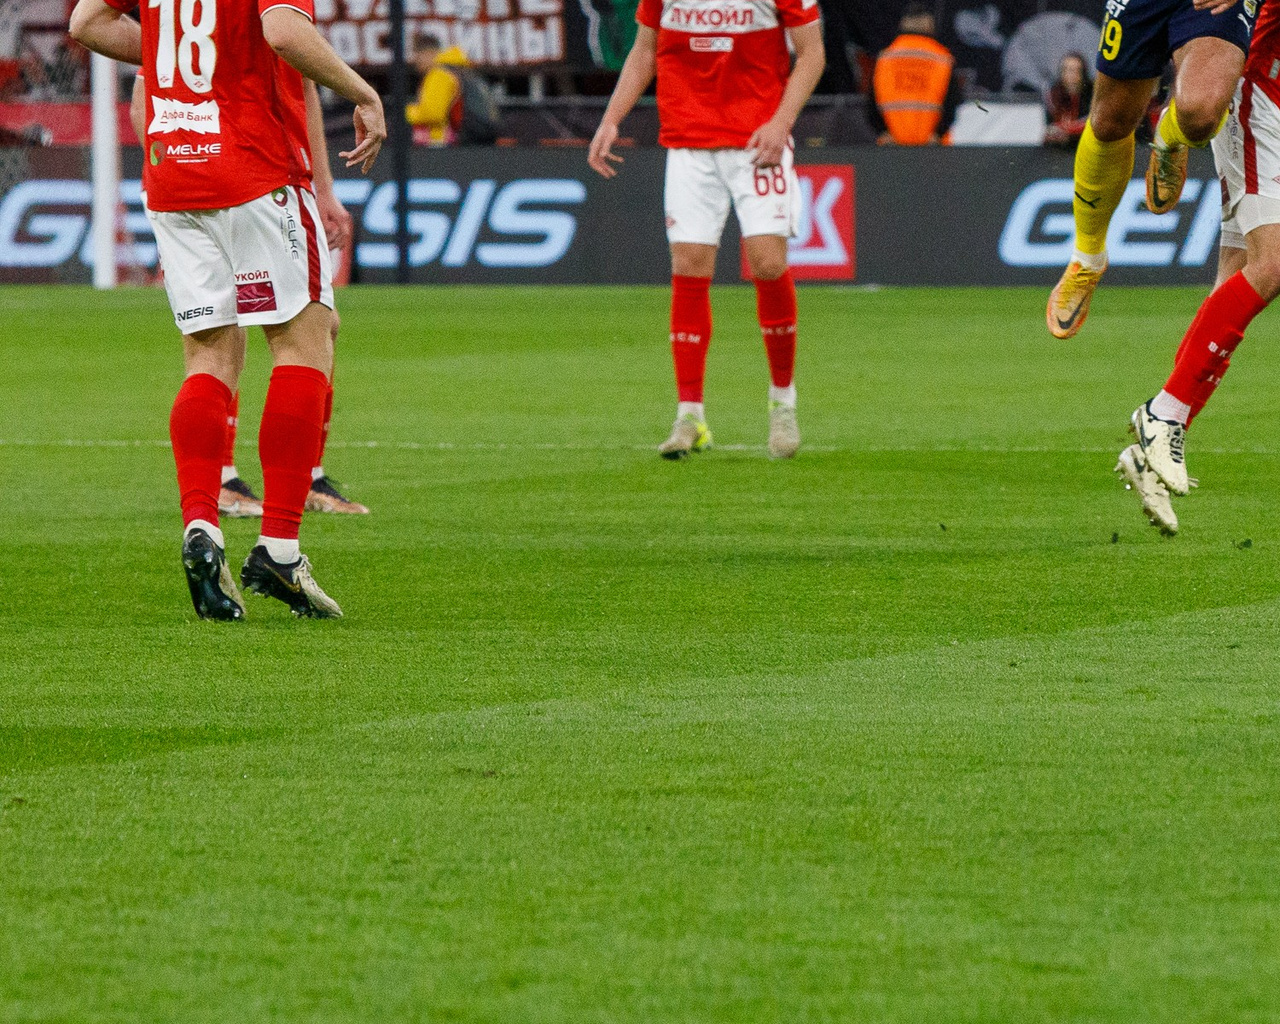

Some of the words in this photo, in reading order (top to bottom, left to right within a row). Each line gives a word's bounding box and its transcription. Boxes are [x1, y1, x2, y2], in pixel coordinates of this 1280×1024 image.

[671, 5, 754, 26] ЛУКОЙЛ
[166, 143, 222, 155] MELKE
[235, 270, 269, 282] УКОЙЛ
